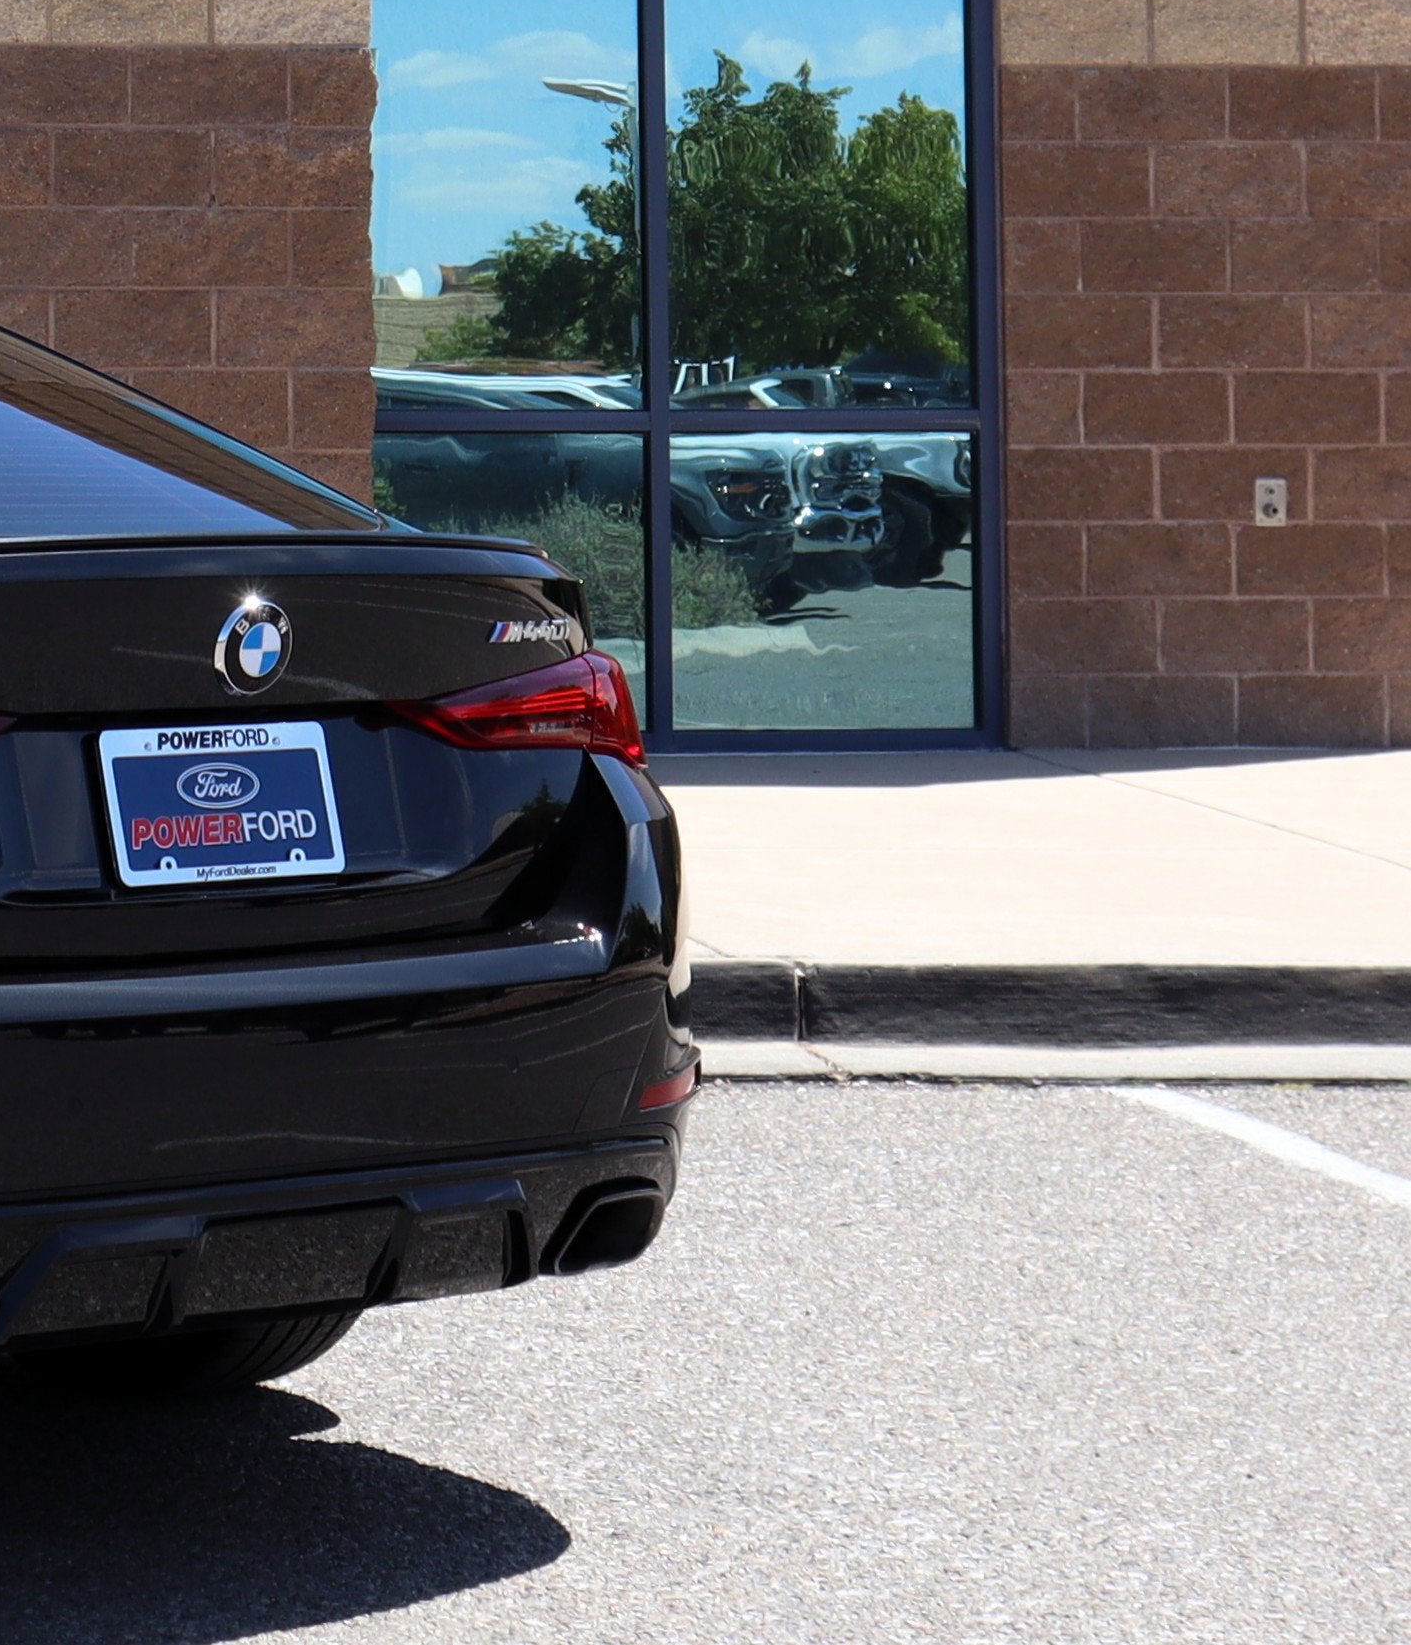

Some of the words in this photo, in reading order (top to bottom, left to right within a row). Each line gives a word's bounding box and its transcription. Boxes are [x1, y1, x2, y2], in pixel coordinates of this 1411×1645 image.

[156, 727, 269, 751] POWERFORD
[194, 770, 242, 799] Ford
[131, 809, 318, 851] POWERFORD
